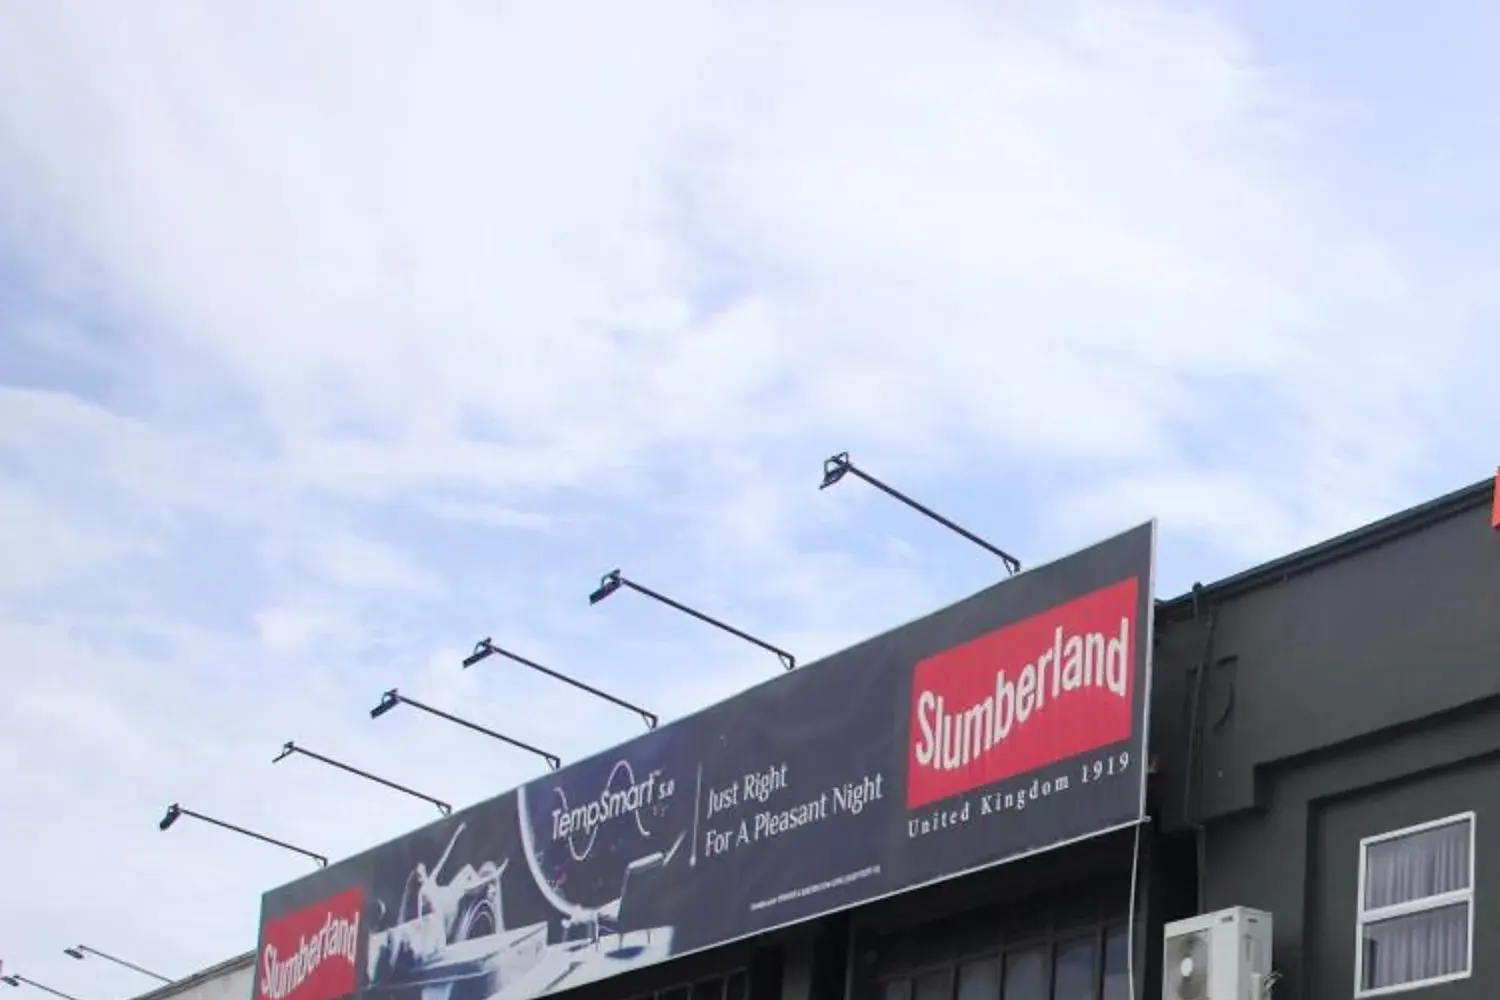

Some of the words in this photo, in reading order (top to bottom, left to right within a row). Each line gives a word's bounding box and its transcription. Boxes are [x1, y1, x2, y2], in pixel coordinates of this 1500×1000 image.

[915, 616, 1129, 770] Slumberland
[705, 830, 733, 857] For
[736, 819, 750, 847] A
[754, 793, 830, 841] Pleasant
[832, 773, 883, 815] Night
[707, 781, 740, 819] Just
[744, 762, 788, 802] Right
[907, 801, 970, 838] United
[981, 776, 1069, 816] Kingdom
[1081, 752, 1130, 784] 1919
[260, 911, 360, 1000] Slumberland
